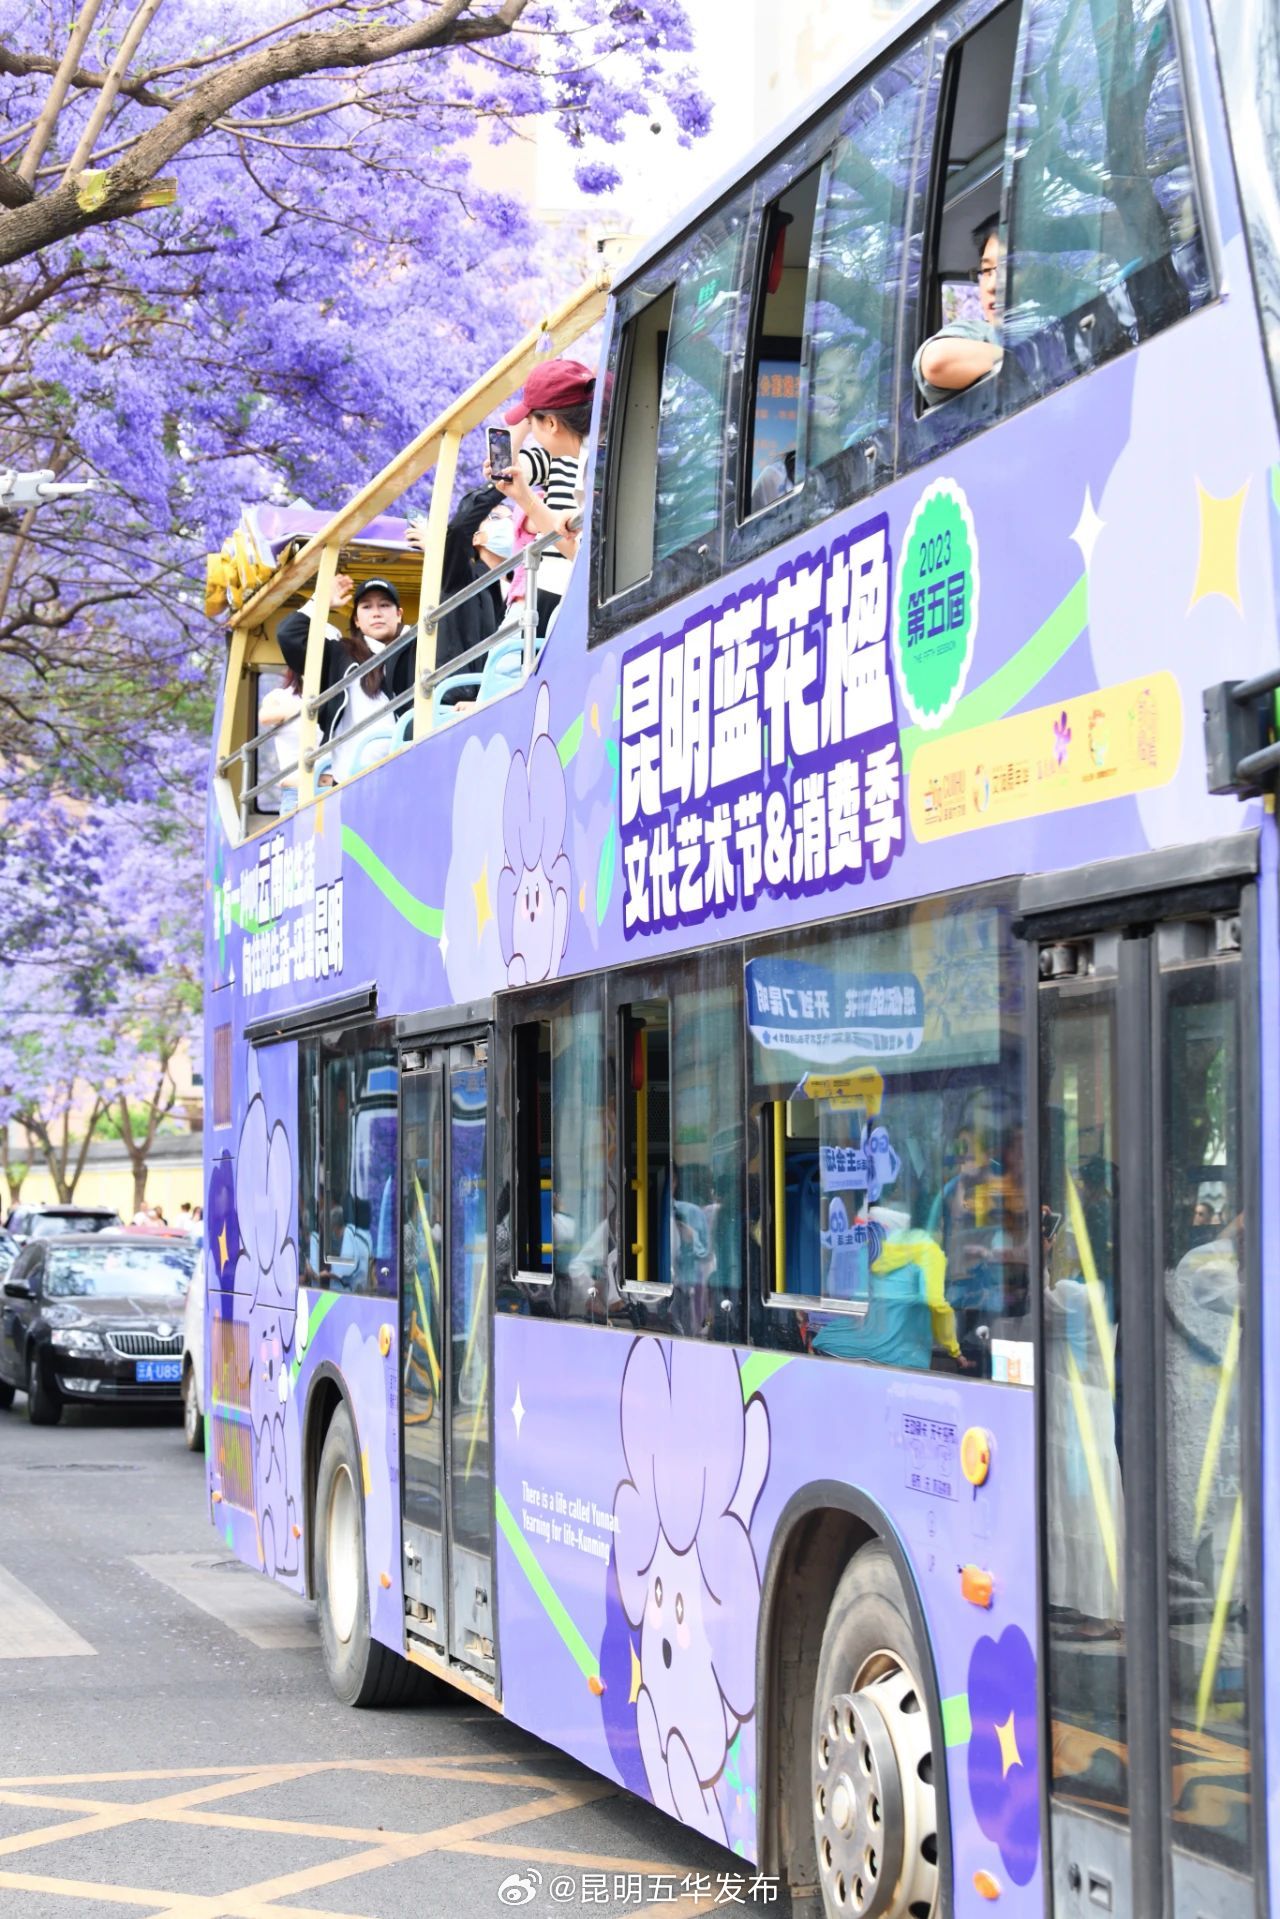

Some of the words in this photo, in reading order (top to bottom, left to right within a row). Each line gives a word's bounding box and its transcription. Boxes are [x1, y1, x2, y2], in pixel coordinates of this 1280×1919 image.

[919, 529, 951, 577] 2023
[907, 570, 965, 648] 第五届
[621, 529, 894, 826] 昆明蓝花楹
[624, 742, 902, 928] 文化艺术节&消费季
[522, 1480, 541, 1506] There
[541, 1487, 548, 1509] is
[549, 1495, 554, 1511] a
[555, 1491, 567, 1515] life
[568, 1498, 591, 1524] called
[522, 1508, 551, 1544] Yearning
[551, 1519, 562, 1542] for
